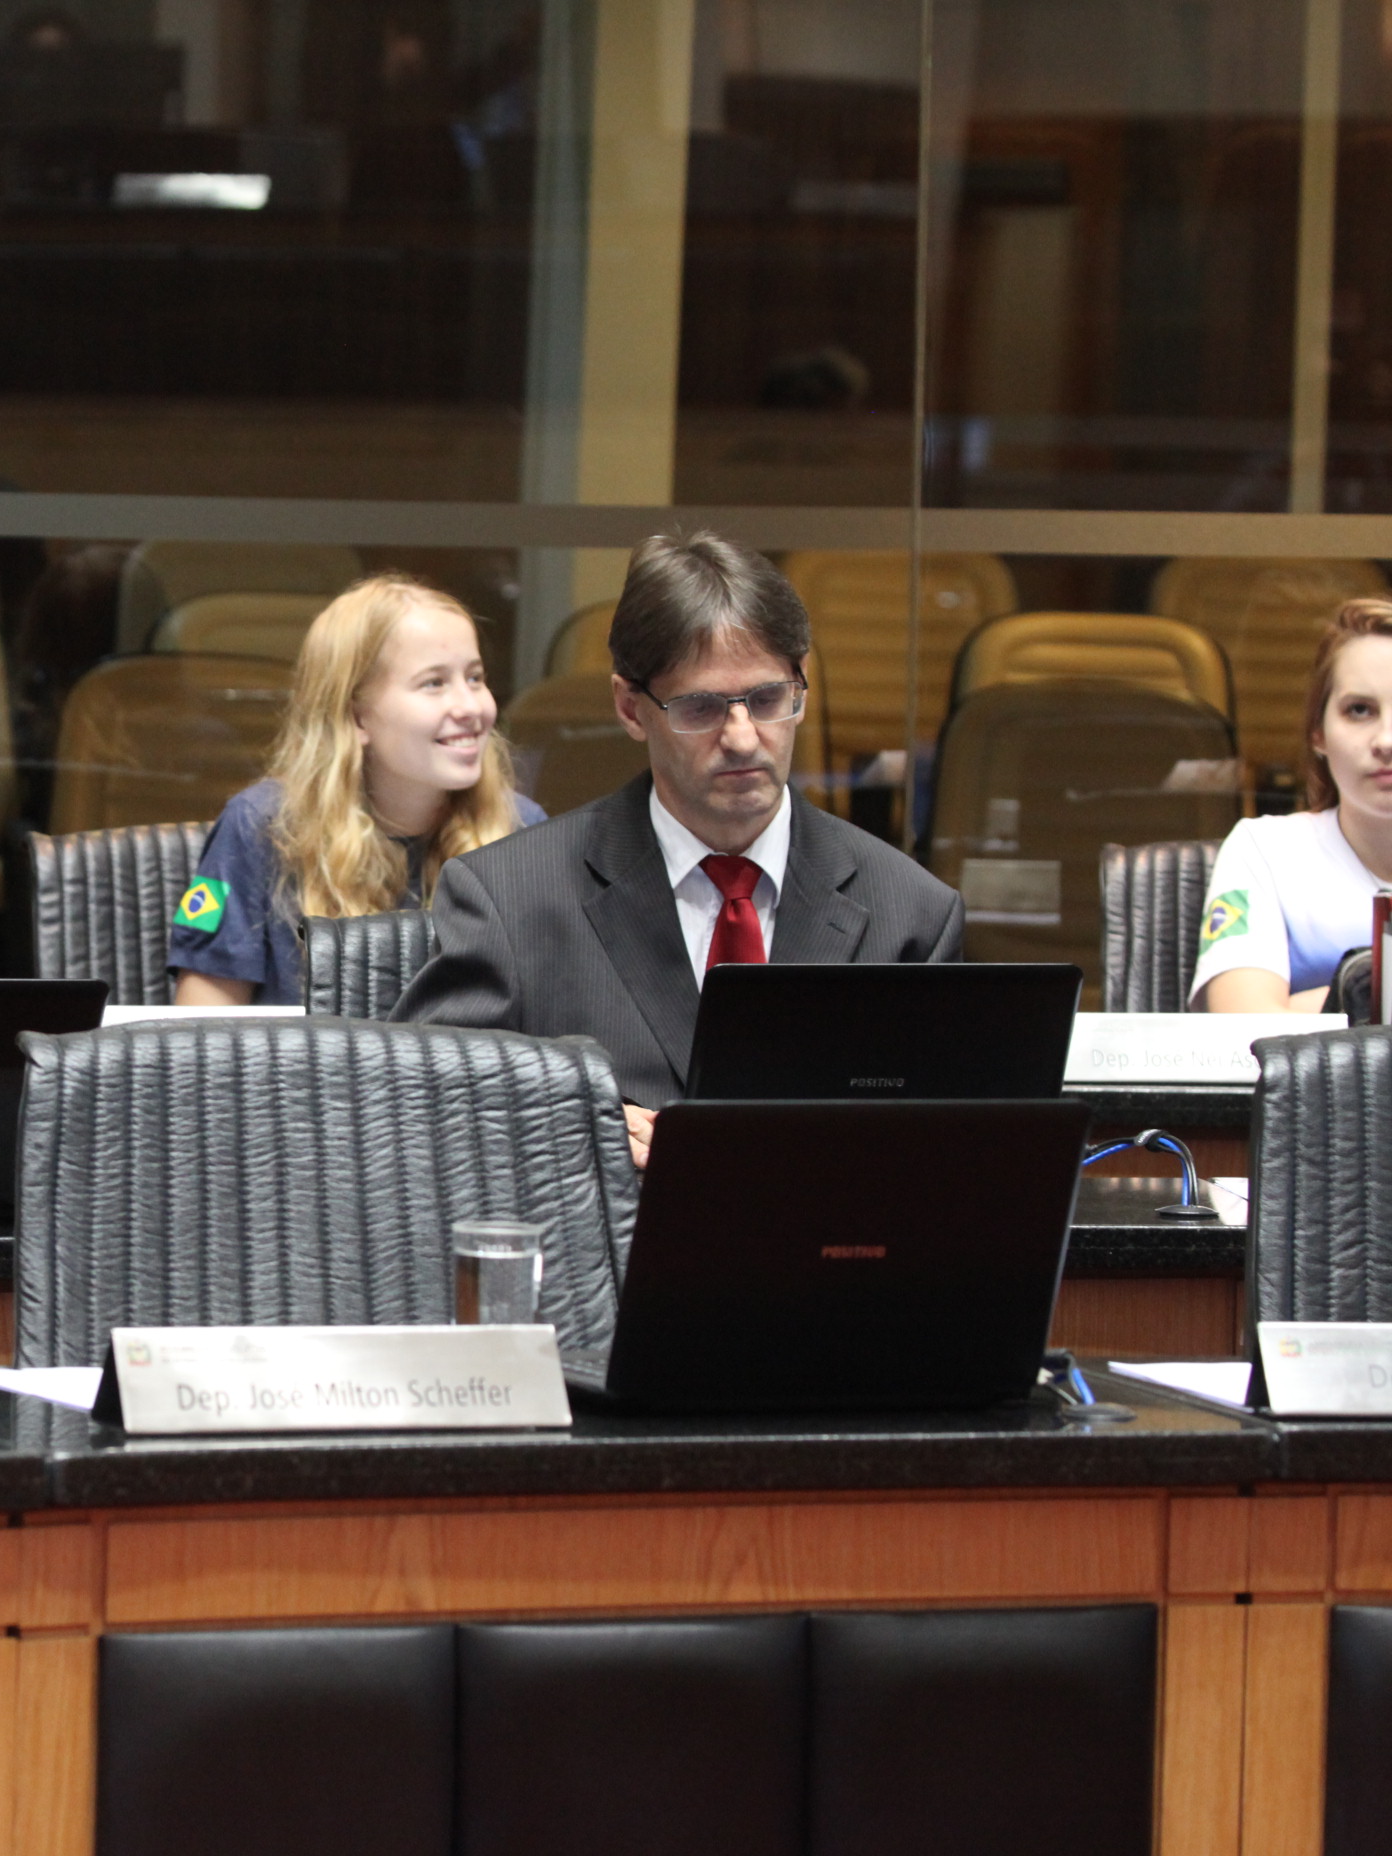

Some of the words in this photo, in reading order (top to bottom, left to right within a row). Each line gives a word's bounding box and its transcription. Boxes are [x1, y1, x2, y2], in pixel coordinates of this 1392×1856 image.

[850, 1077, 905, 1088] POSITIVO
[175, 1382, 238, 1416] Dep.
[314, 1380, 400, 1410] Milton
[408, 1375, 513, 1408] Scheffer
